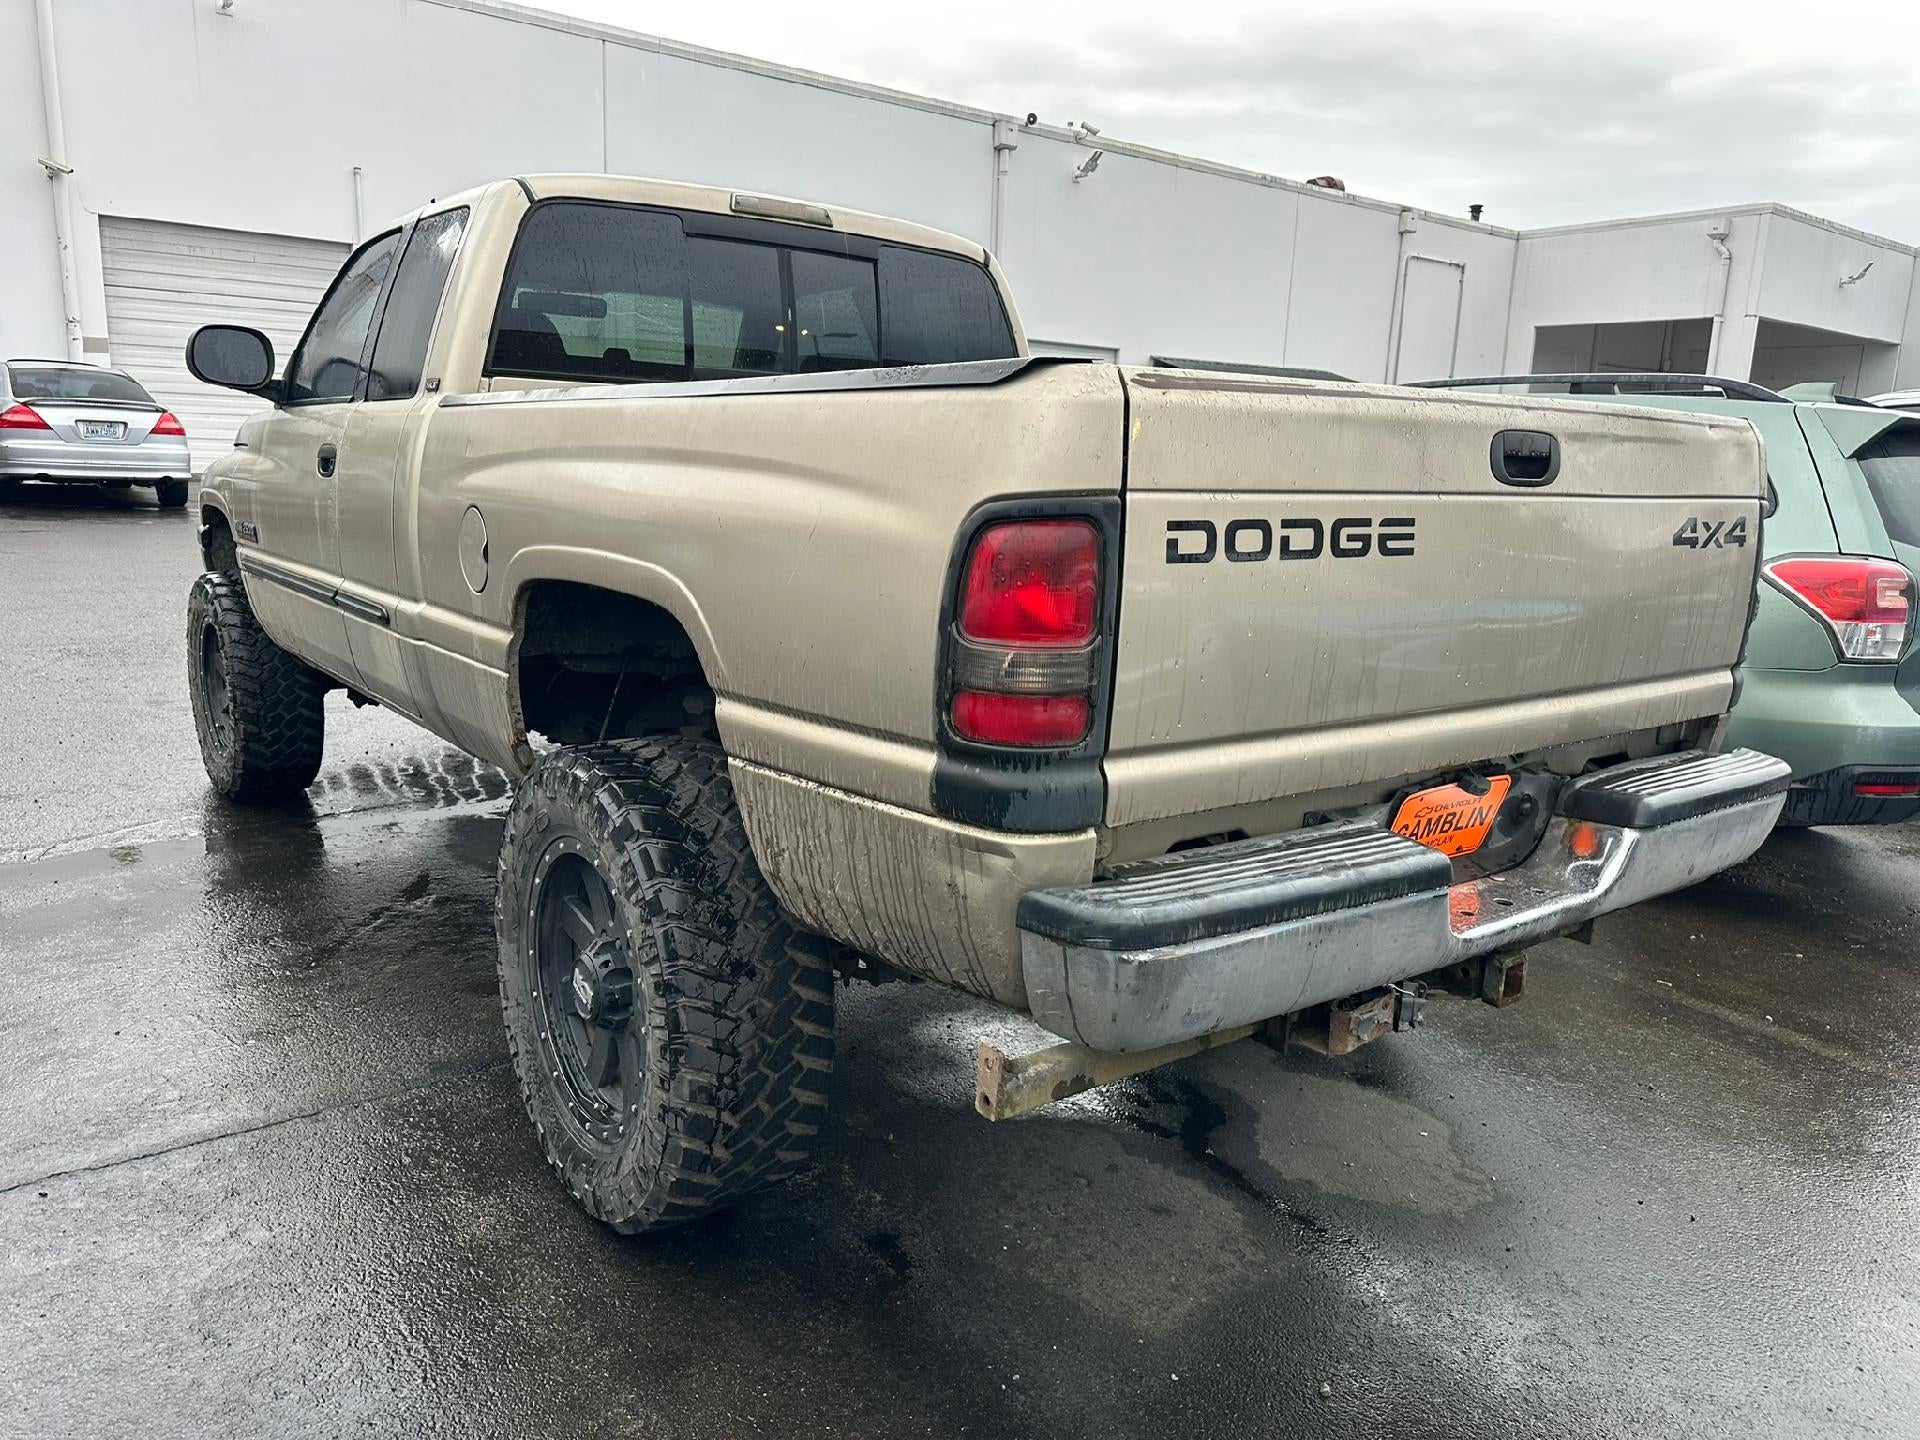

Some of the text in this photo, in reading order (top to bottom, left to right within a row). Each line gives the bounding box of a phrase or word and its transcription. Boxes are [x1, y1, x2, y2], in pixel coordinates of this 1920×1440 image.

[1166, 518, 1416, 564] DODGE
[1397, 804, 1493, 841] GAMBLIN
[1433, 797, 1482, 813] CHEVROLET
